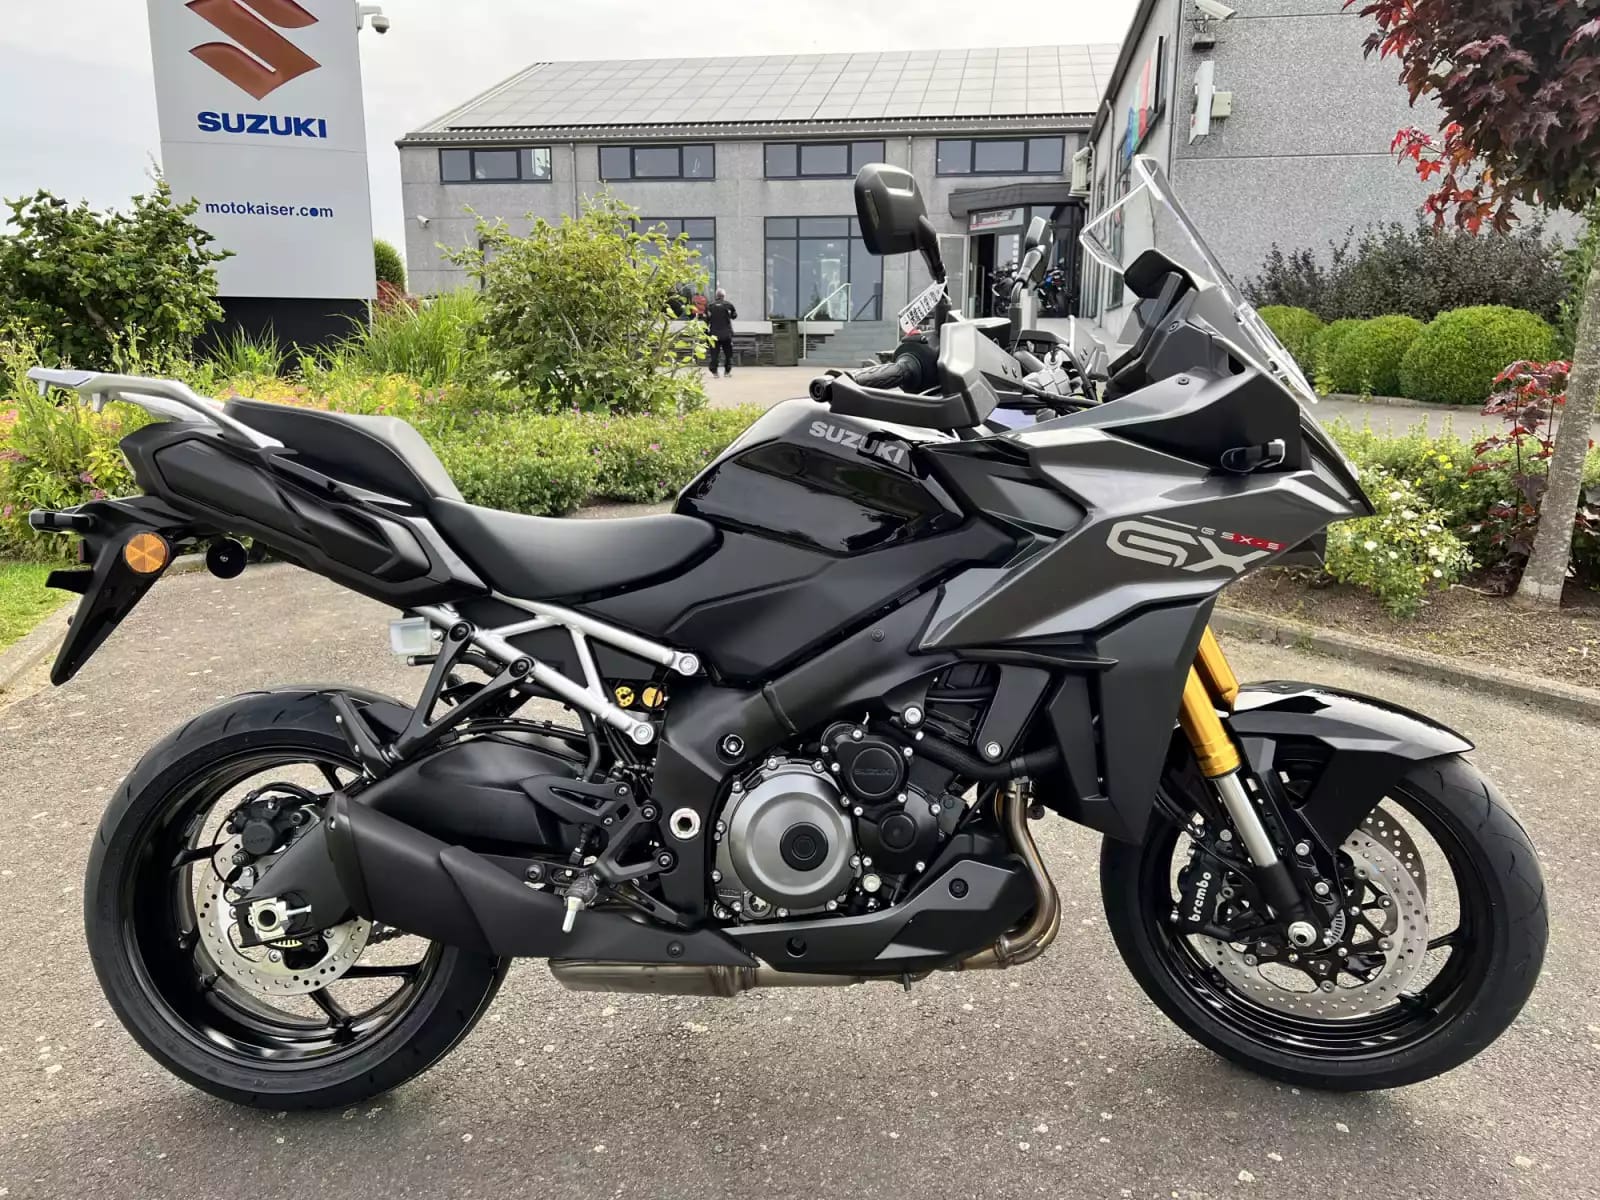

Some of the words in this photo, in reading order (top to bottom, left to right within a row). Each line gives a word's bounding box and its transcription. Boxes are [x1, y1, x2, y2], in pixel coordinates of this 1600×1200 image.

[197, 111, 328, 138] SUZUKI
[205, 202, 333, 218] motokaiser.com
[809, 420, 905, 464] SUZUKI
[1188, 871, 1212, 922] brembo
